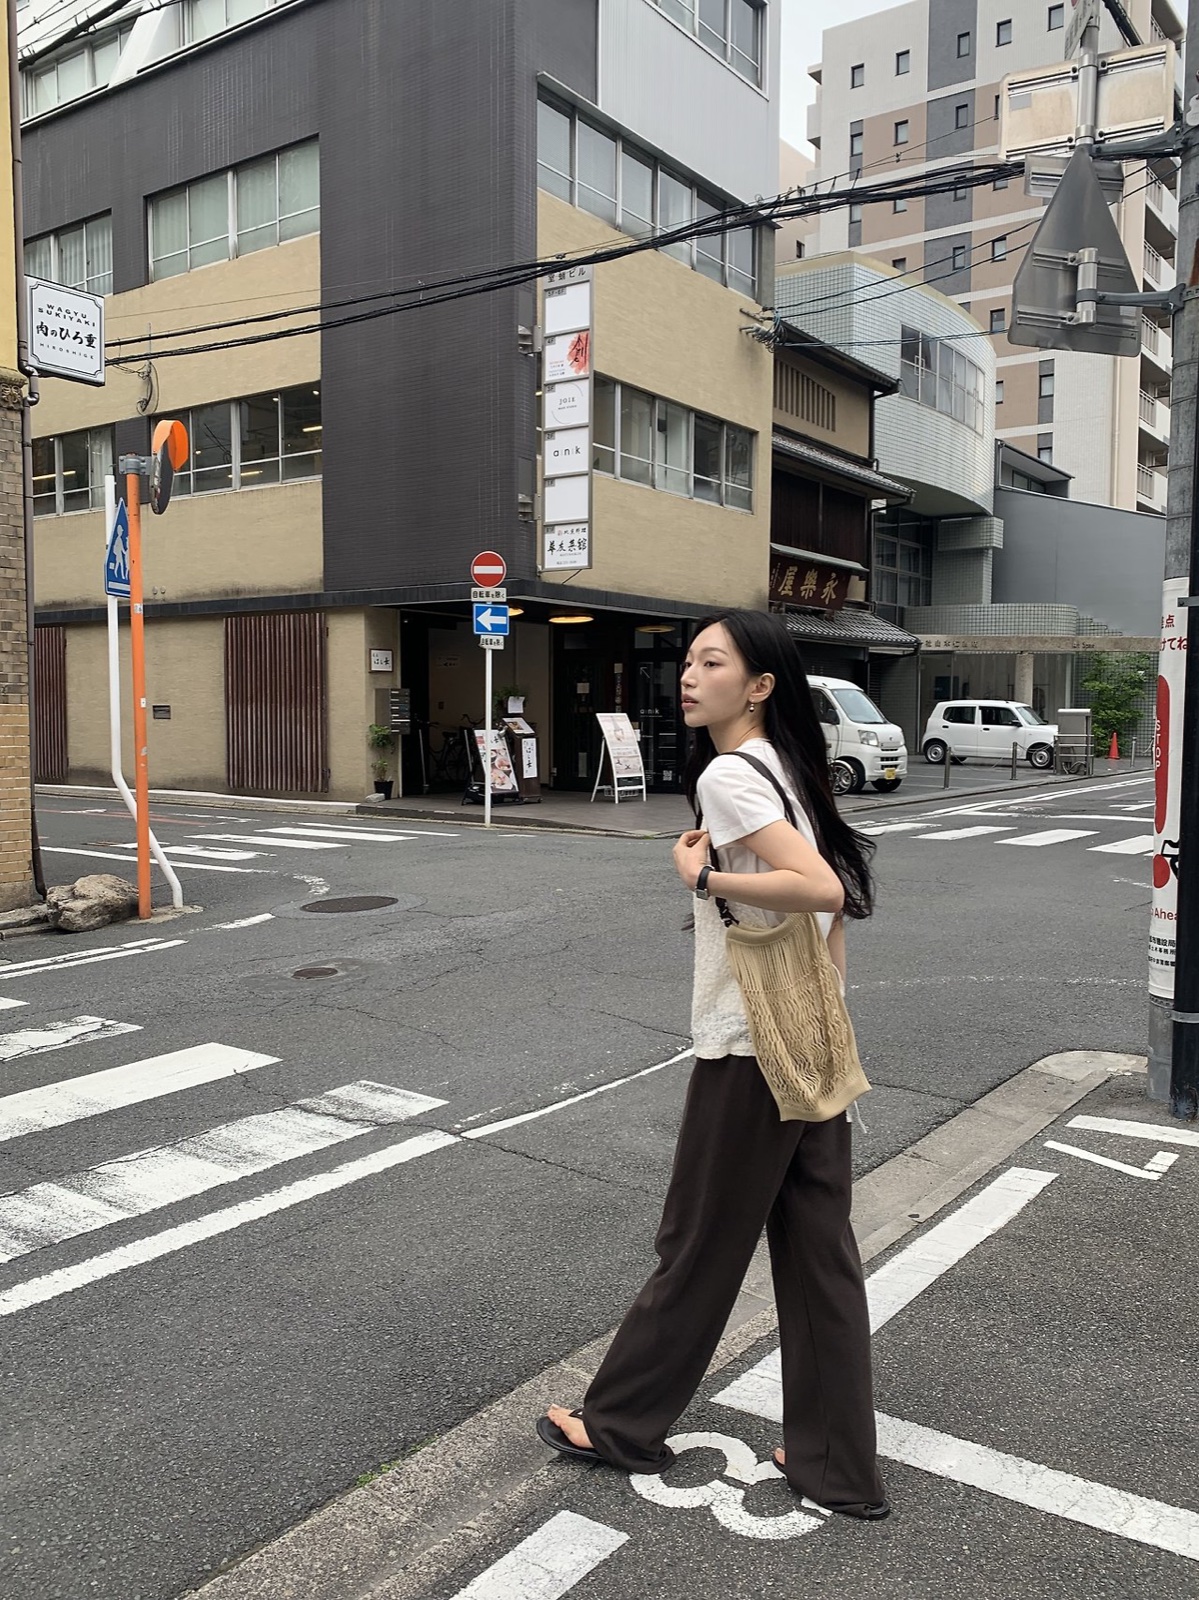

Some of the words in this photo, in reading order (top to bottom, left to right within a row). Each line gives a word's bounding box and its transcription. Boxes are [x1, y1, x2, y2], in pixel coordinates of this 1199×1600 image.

[38, 307, 96, 327] SUKIYAKI
[46, 303, 87, 319] WAGYU
[36, 321, 97, 349] 肉のひろ重
[39, 342, 95, 360] HIROSHIGE
[559, 397, 576, 405] JOIE
[472, 590, 505, 599] 自転車を除く
